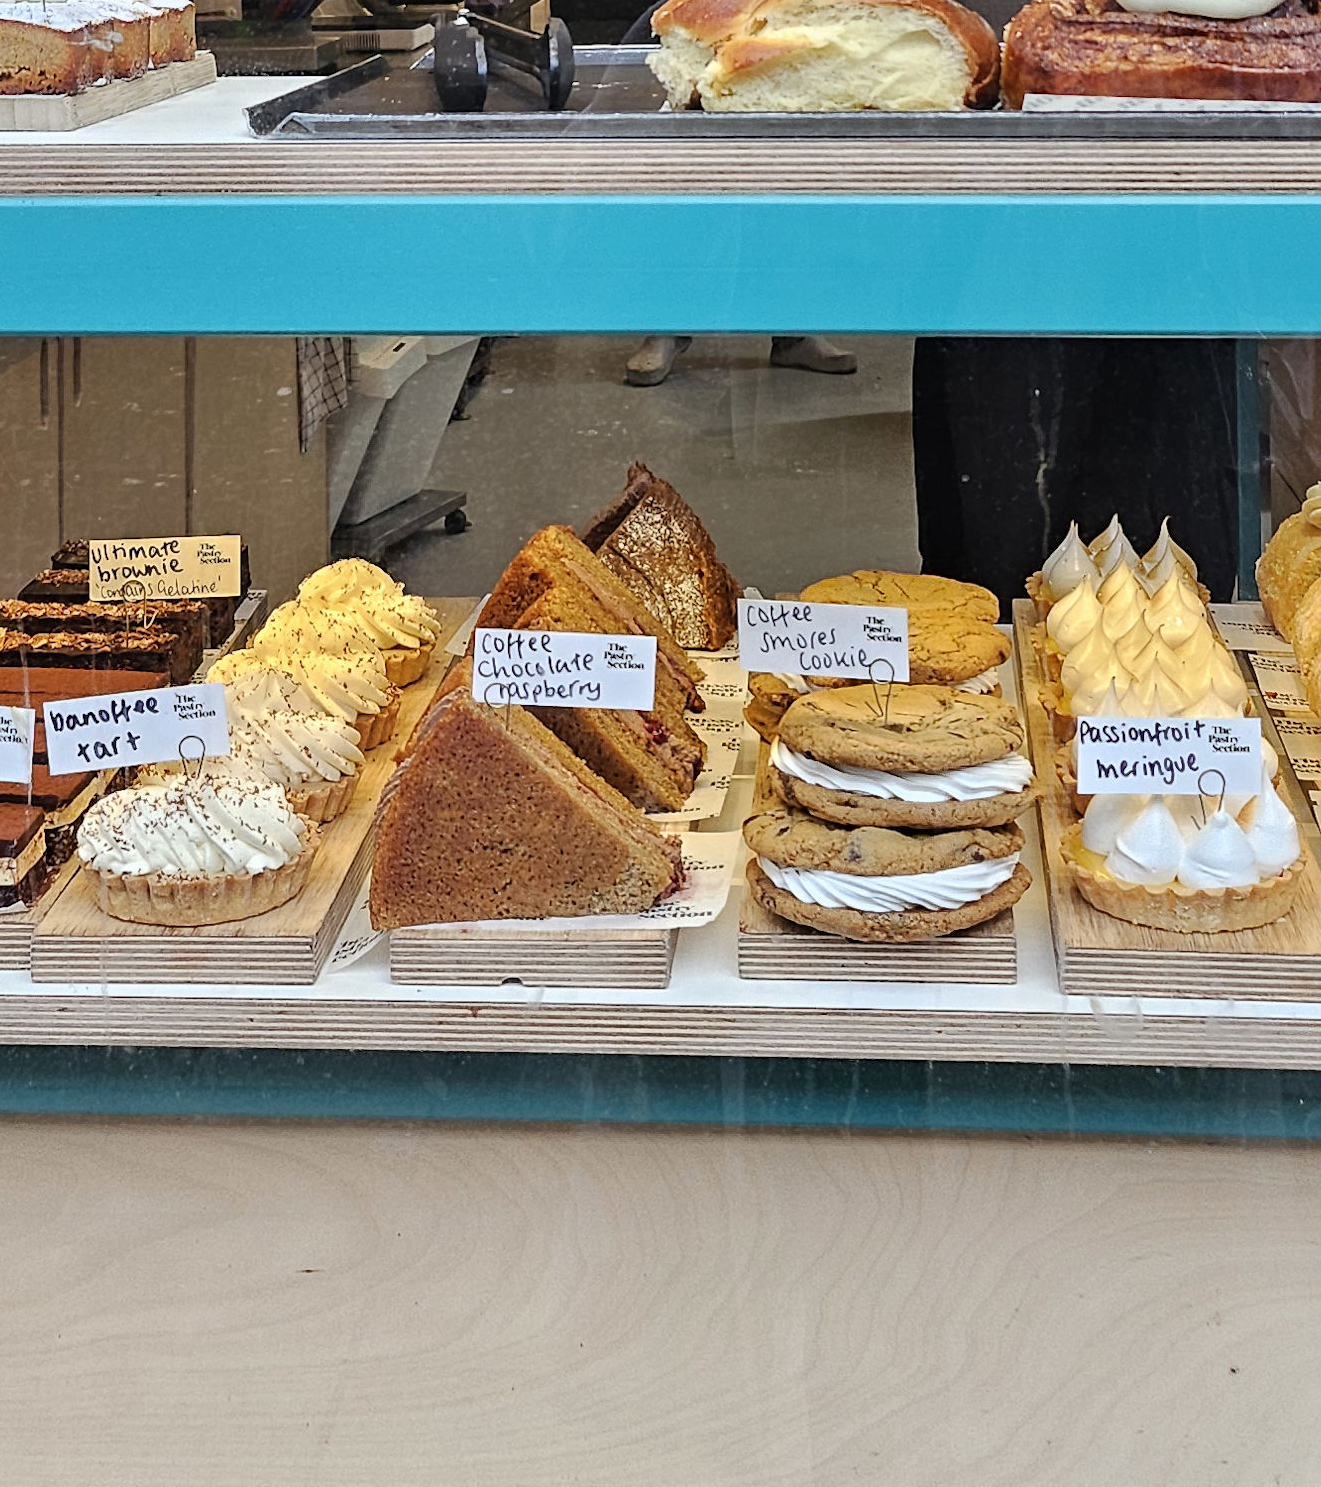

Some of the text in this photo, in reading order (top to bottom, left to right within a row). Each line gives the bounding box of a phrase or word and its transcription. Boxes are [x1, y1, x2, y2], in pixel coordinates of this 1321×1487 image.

[91, 540, 180, 564] Ultimate
[97, 558, 184, 582] brownie
[866, 616, 885, 625] The
[867, 633, 902, 643] Section
[607, 643, 628, 652] The
[607, 660, 645, 670] Section
[499, 680, 601, 702] raspberry
[177, 694, 196, 703] The
[50, 696, 160, 732] banoffee
[178, 710, 216, 721] Section
[1211, 726, 1232, 735] The
[1208, 735, 1241, 744] Pastry
[77, 731, 140, 763] tart
[1212, 744, 1250, 753] Section
[1097, 753, 1199, 785] meringue
